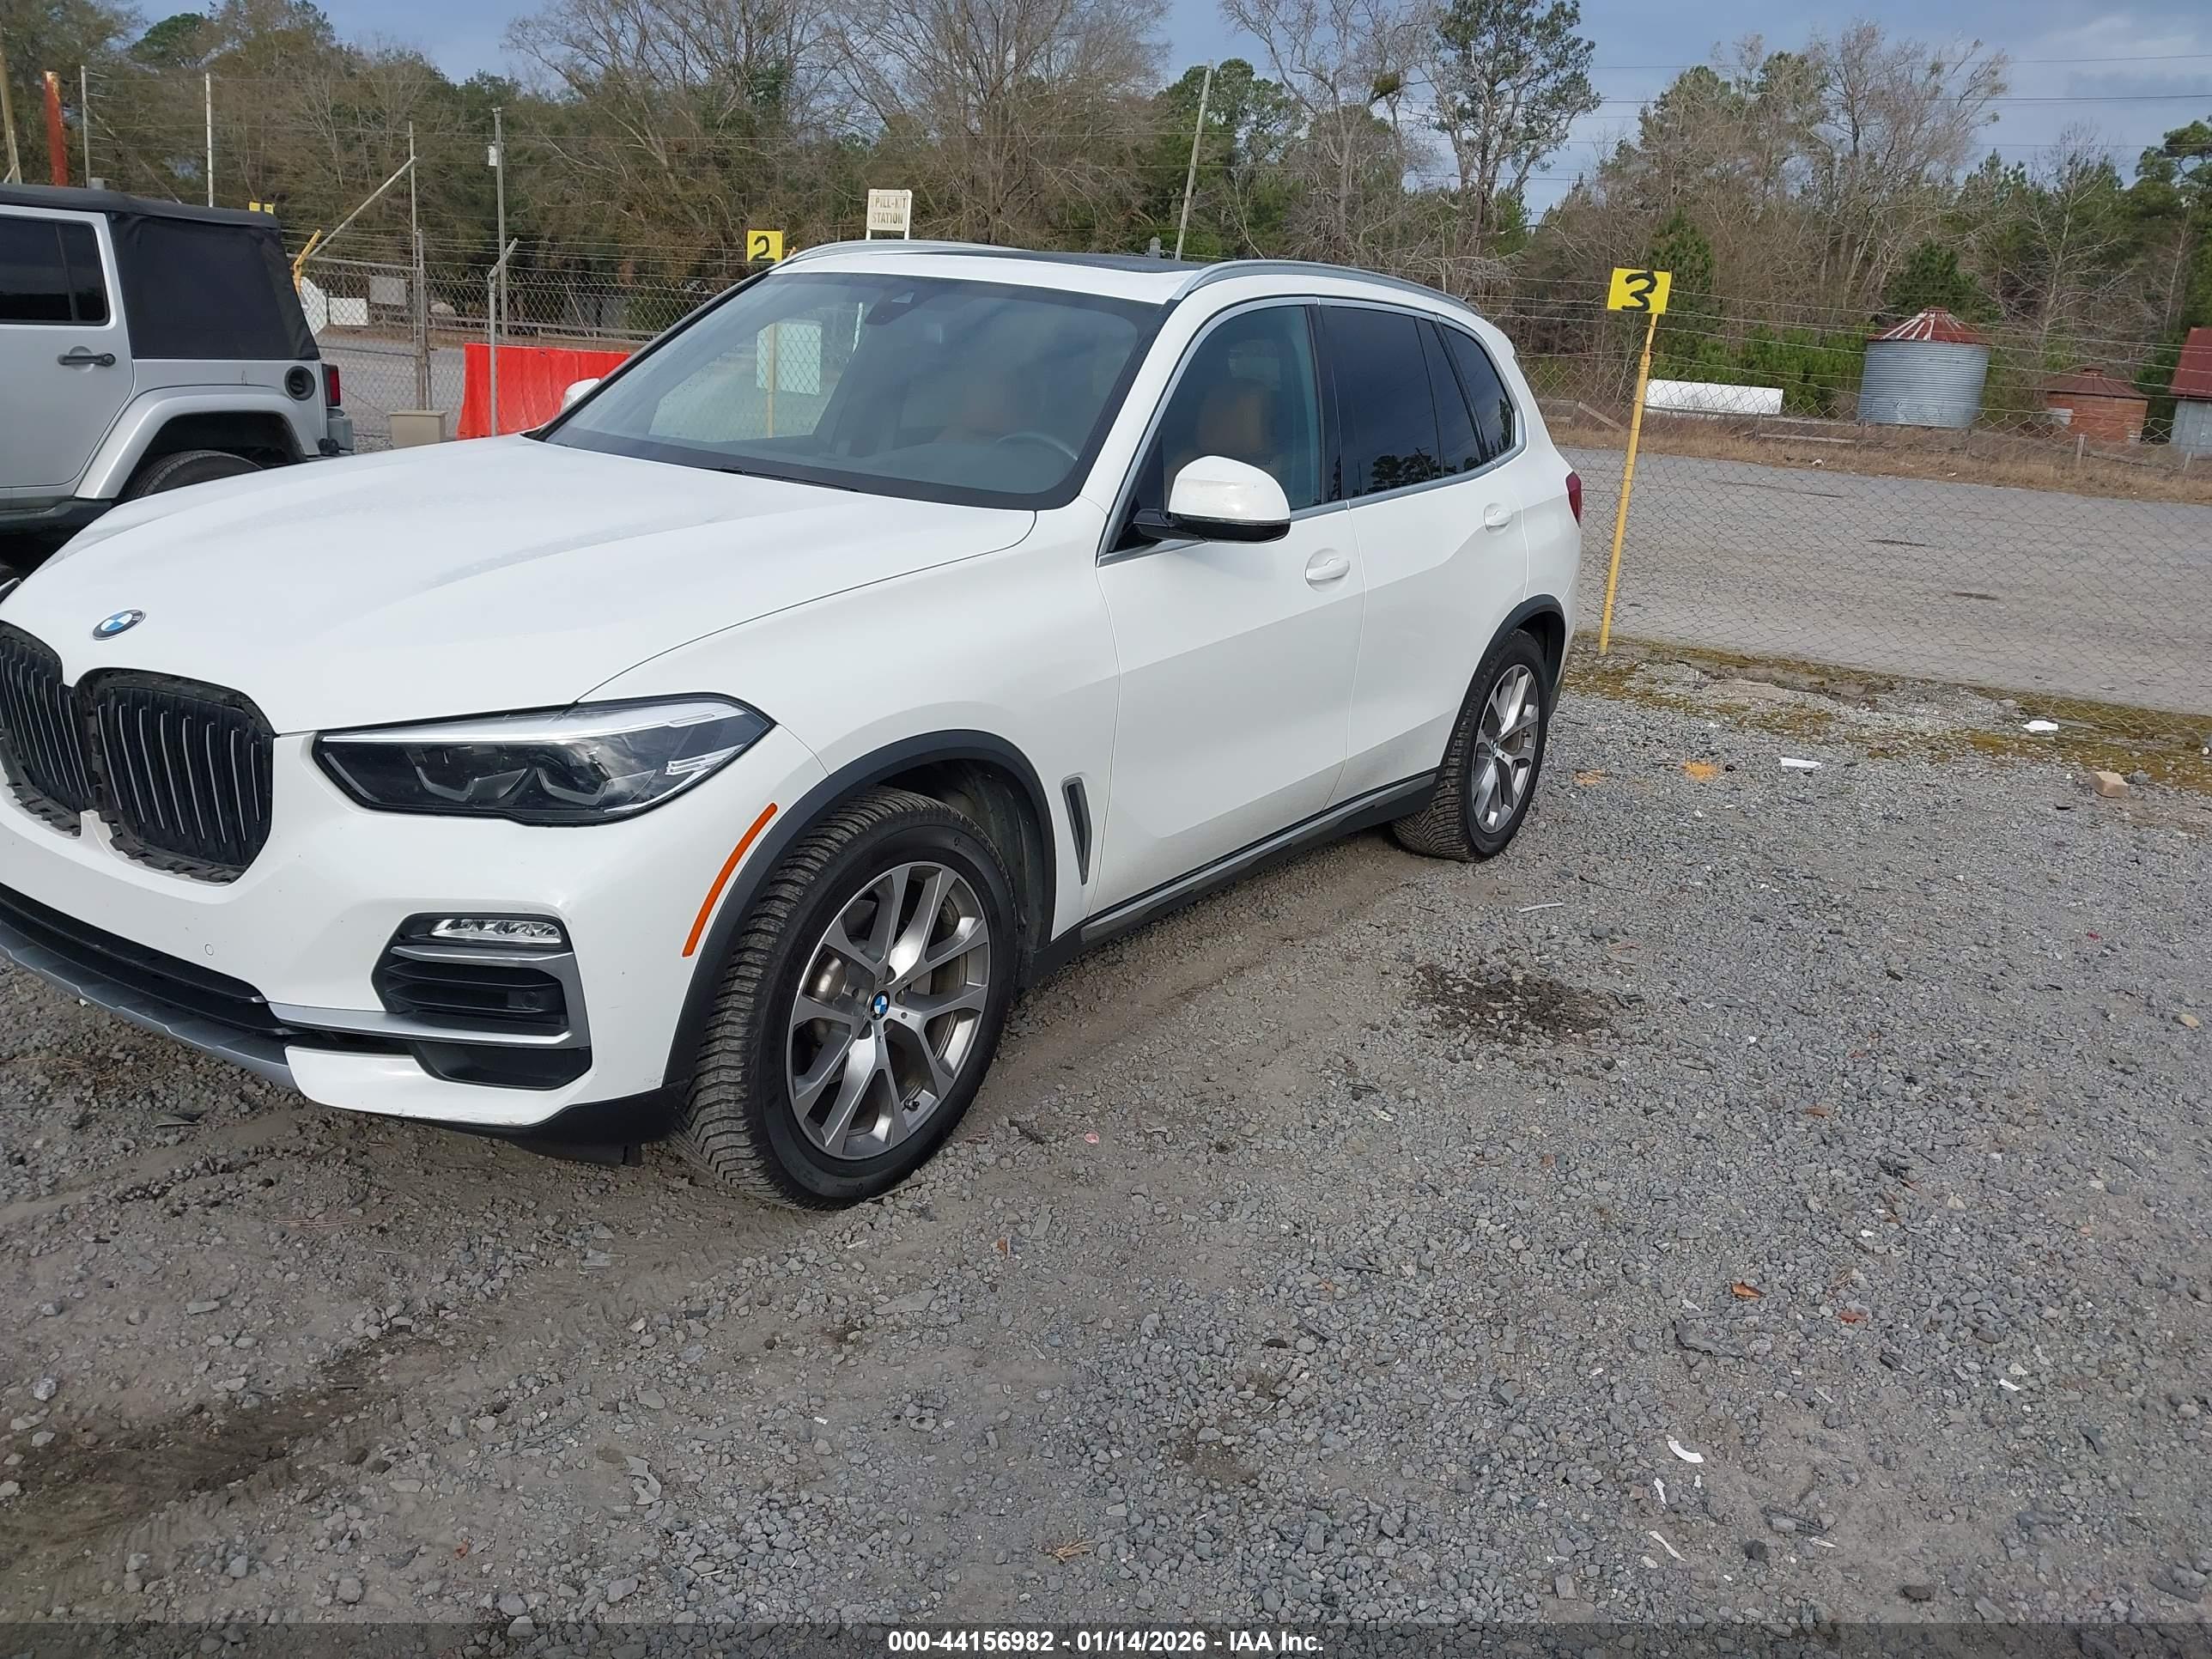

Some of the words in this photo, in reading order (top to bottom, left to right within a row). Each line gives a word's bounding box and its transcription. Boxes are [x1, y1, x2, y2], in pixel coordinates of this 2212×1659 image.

[872, 212, 903, 224] STATION
[750, 234, 775, 262] 2
[1621, 270, 1657, 312] 3
